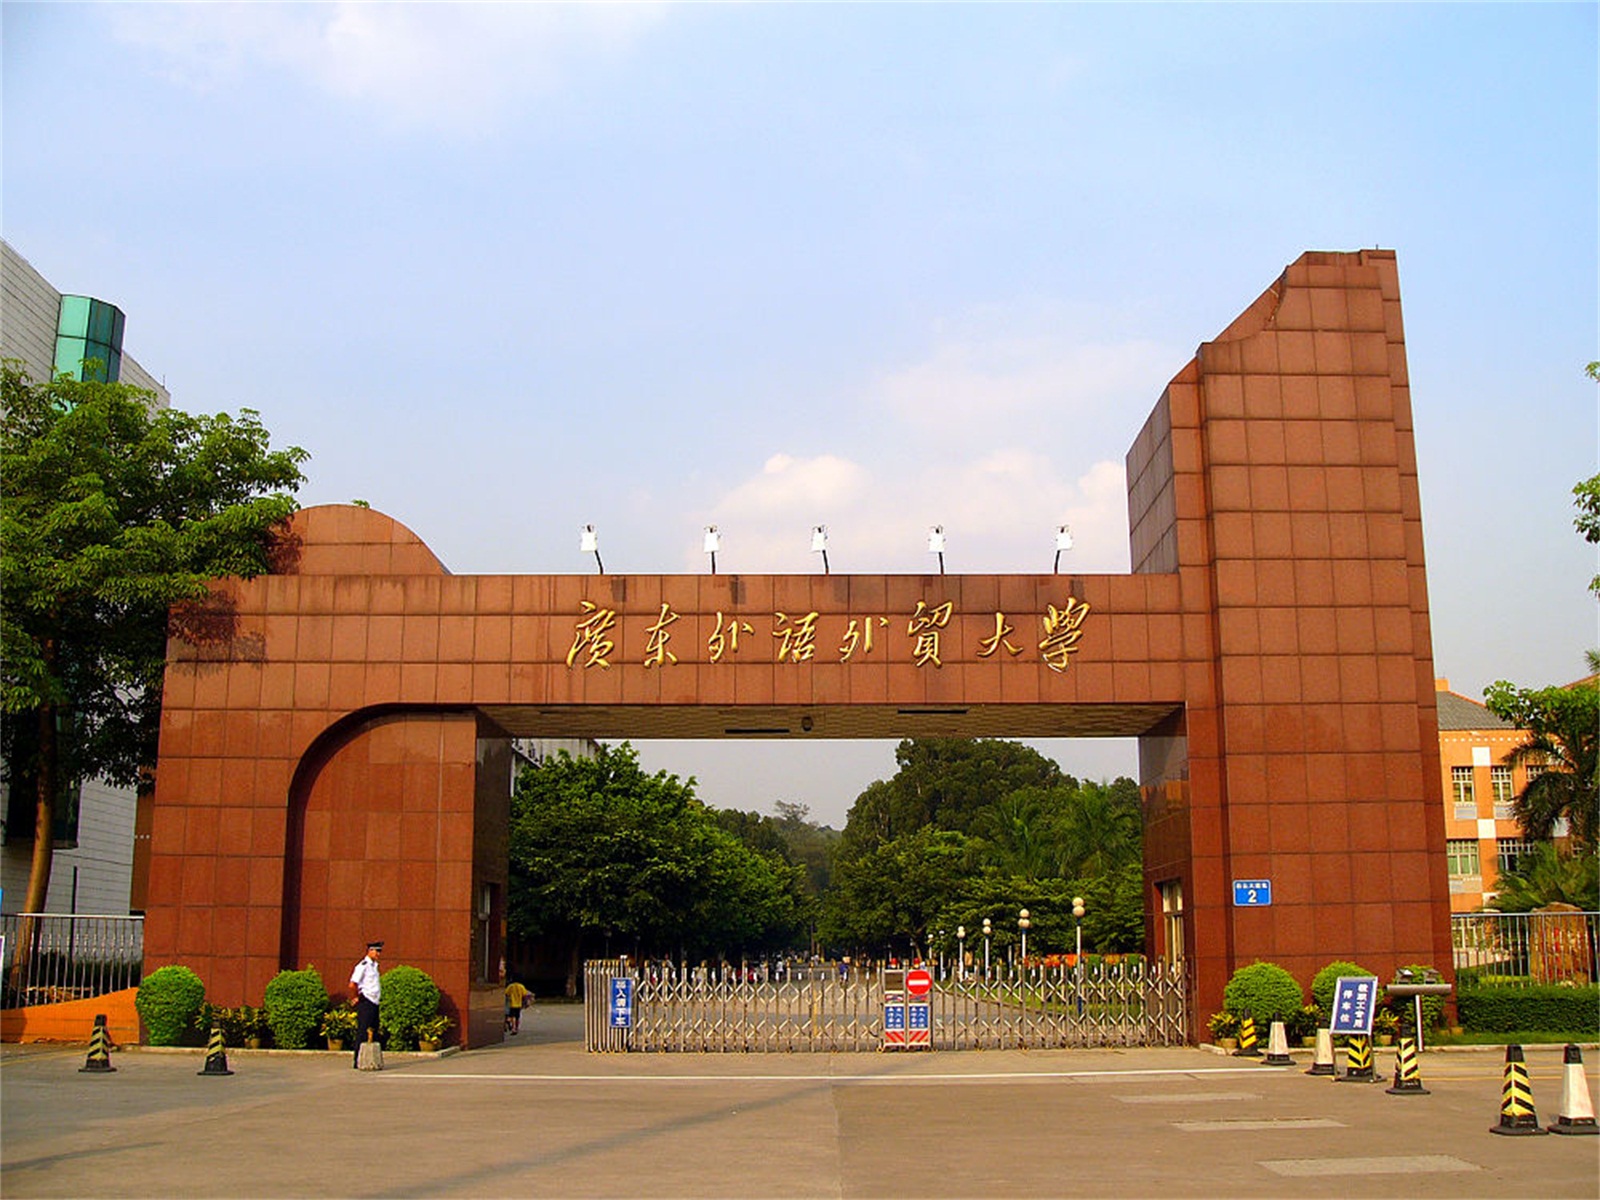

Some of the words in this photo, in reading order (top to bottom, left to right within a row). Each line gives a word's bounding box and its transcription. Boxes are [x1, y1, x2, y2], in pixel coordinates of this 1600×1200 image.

[1247, 889, 1257, 903] 2
[1339, 989, 1353, 1024] 停车位
